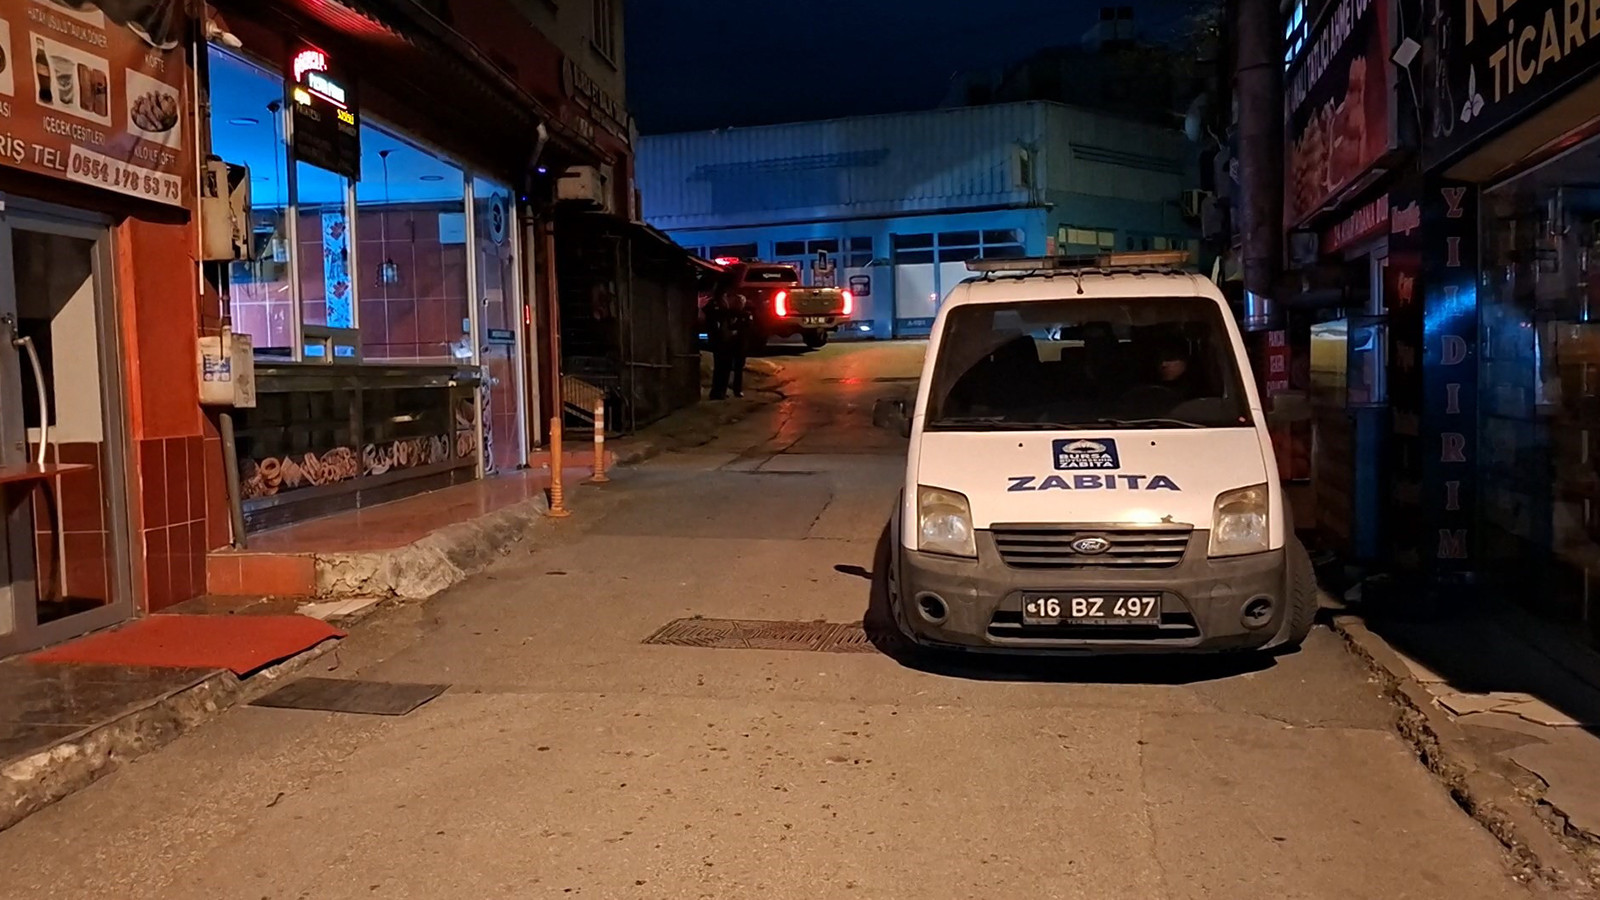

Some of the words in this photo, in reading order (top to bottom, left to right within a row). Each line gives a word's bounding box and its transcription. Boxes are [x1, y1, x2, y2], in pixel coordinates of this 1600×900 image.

[32, 144, 65, 170] TEL
[72, 153, 109, 182] 0554
[114, 167, 139, 191] 178
[144, 175, 160, 196] 53
[164, 180, 179, 200] 73
[1438, 187, 1468, 559] YILDIRIM
[1007, 474, 1182, 492] ZABITA
[1079, 539, 1101, 550] Ford
[1036, 598, 1061, 617] 16
[1071, 598, 1104, 617] BZ
[1113, 598, 1155, 617] 497
